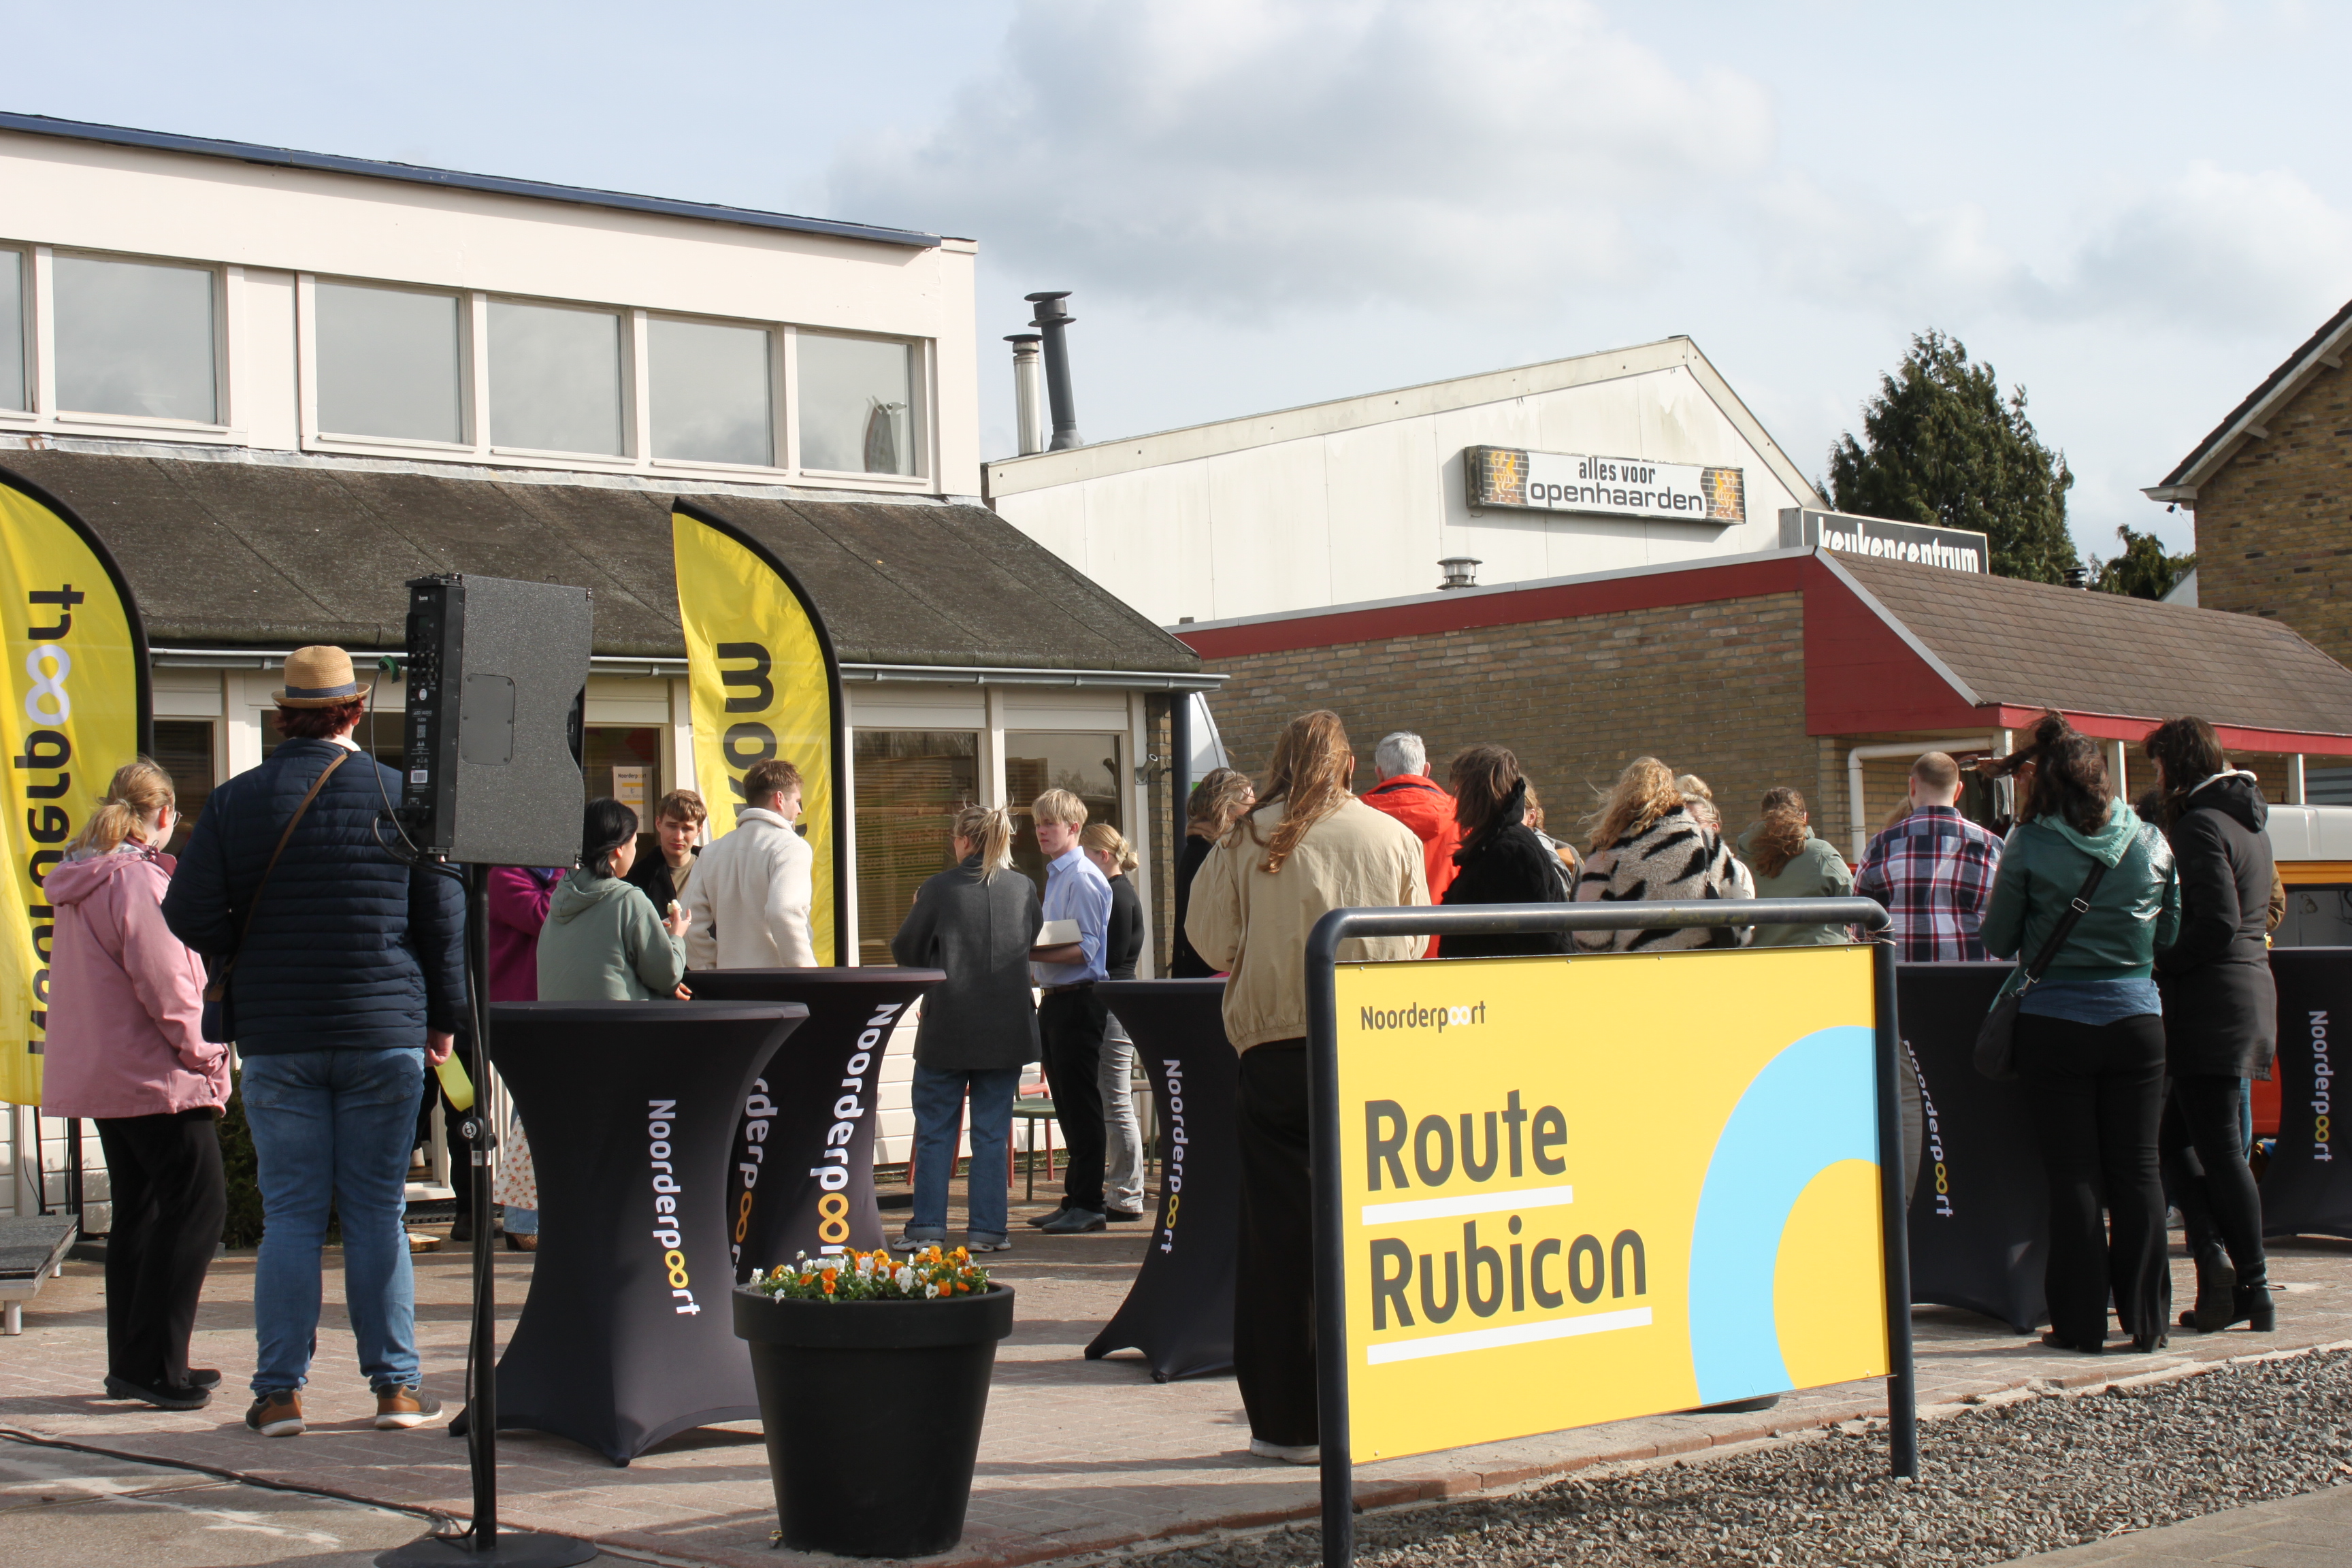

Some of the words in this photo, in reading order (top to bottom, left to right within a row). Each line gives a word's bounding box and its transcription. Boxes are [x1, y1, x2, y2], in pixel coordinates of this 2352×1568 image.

[1530, 482, 1703, 511] openhaarden
[1578, 457, 1617, 482] alles
[1621, 465, 1656, 485] voor
[1818, 516, 1979, 574] keukencentrum
[1360, 1000, 1486, 1033] Noorderpoort
[809, 1003, 904, 1254] Noorderpoo
[1364, 1089, 1569, 1192] Route
[1903, 1039, 1954, 1218] Noorderpoort
[2308, 1010, 2335, 1162] Noorderpoort
[648, 1099, 701, 1316] Noorderpoort
[1160, 1059, 1189, 1254] Noorderpoort
[1369, 1214, 1648, 1332] Rubicon
